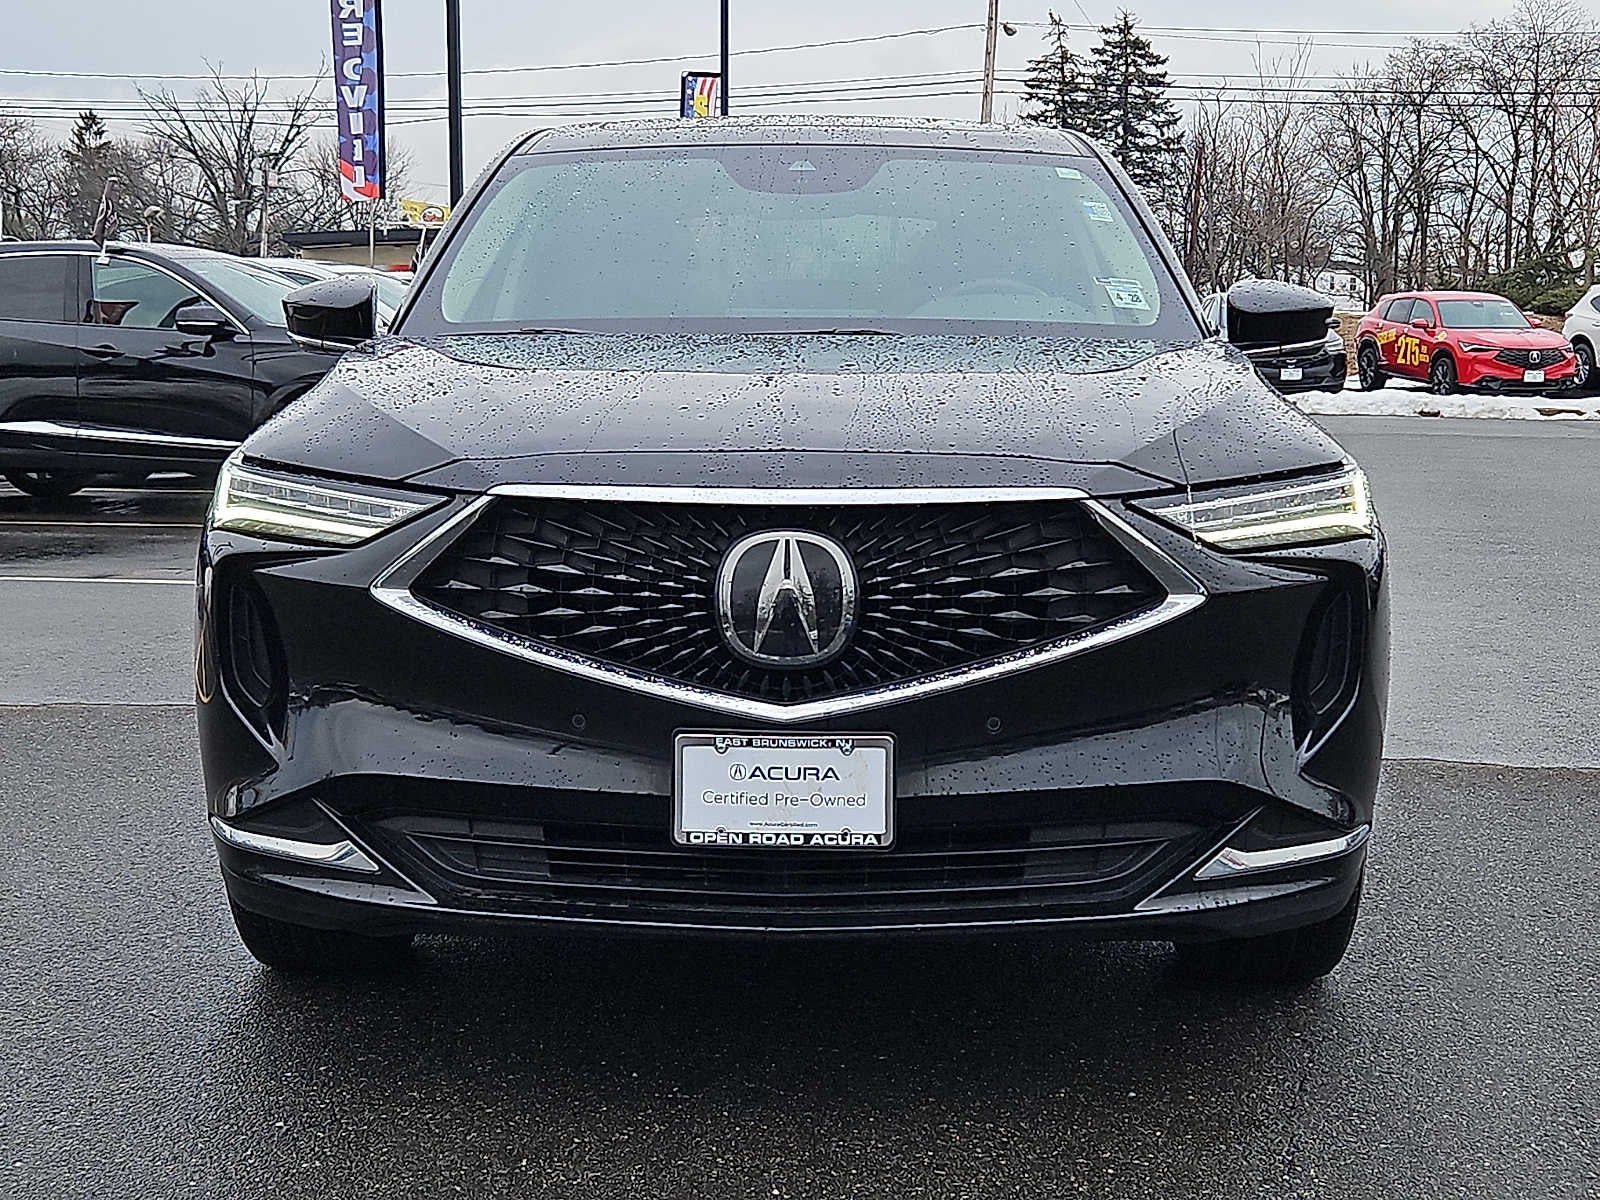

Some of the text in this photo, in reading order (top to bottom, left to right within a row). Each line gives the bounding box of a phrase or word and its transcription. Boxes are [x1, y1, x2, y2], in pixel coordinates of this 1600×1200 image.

[715, 737, 748, 747] EAST
[835, 739, 853, 749] NJ
[748, 766, 840, 781] ACURA
[702, 790, 866, 807] Certified Pre-Owned
[689, 831, 879, 845] OPEN ROAD ACURA
